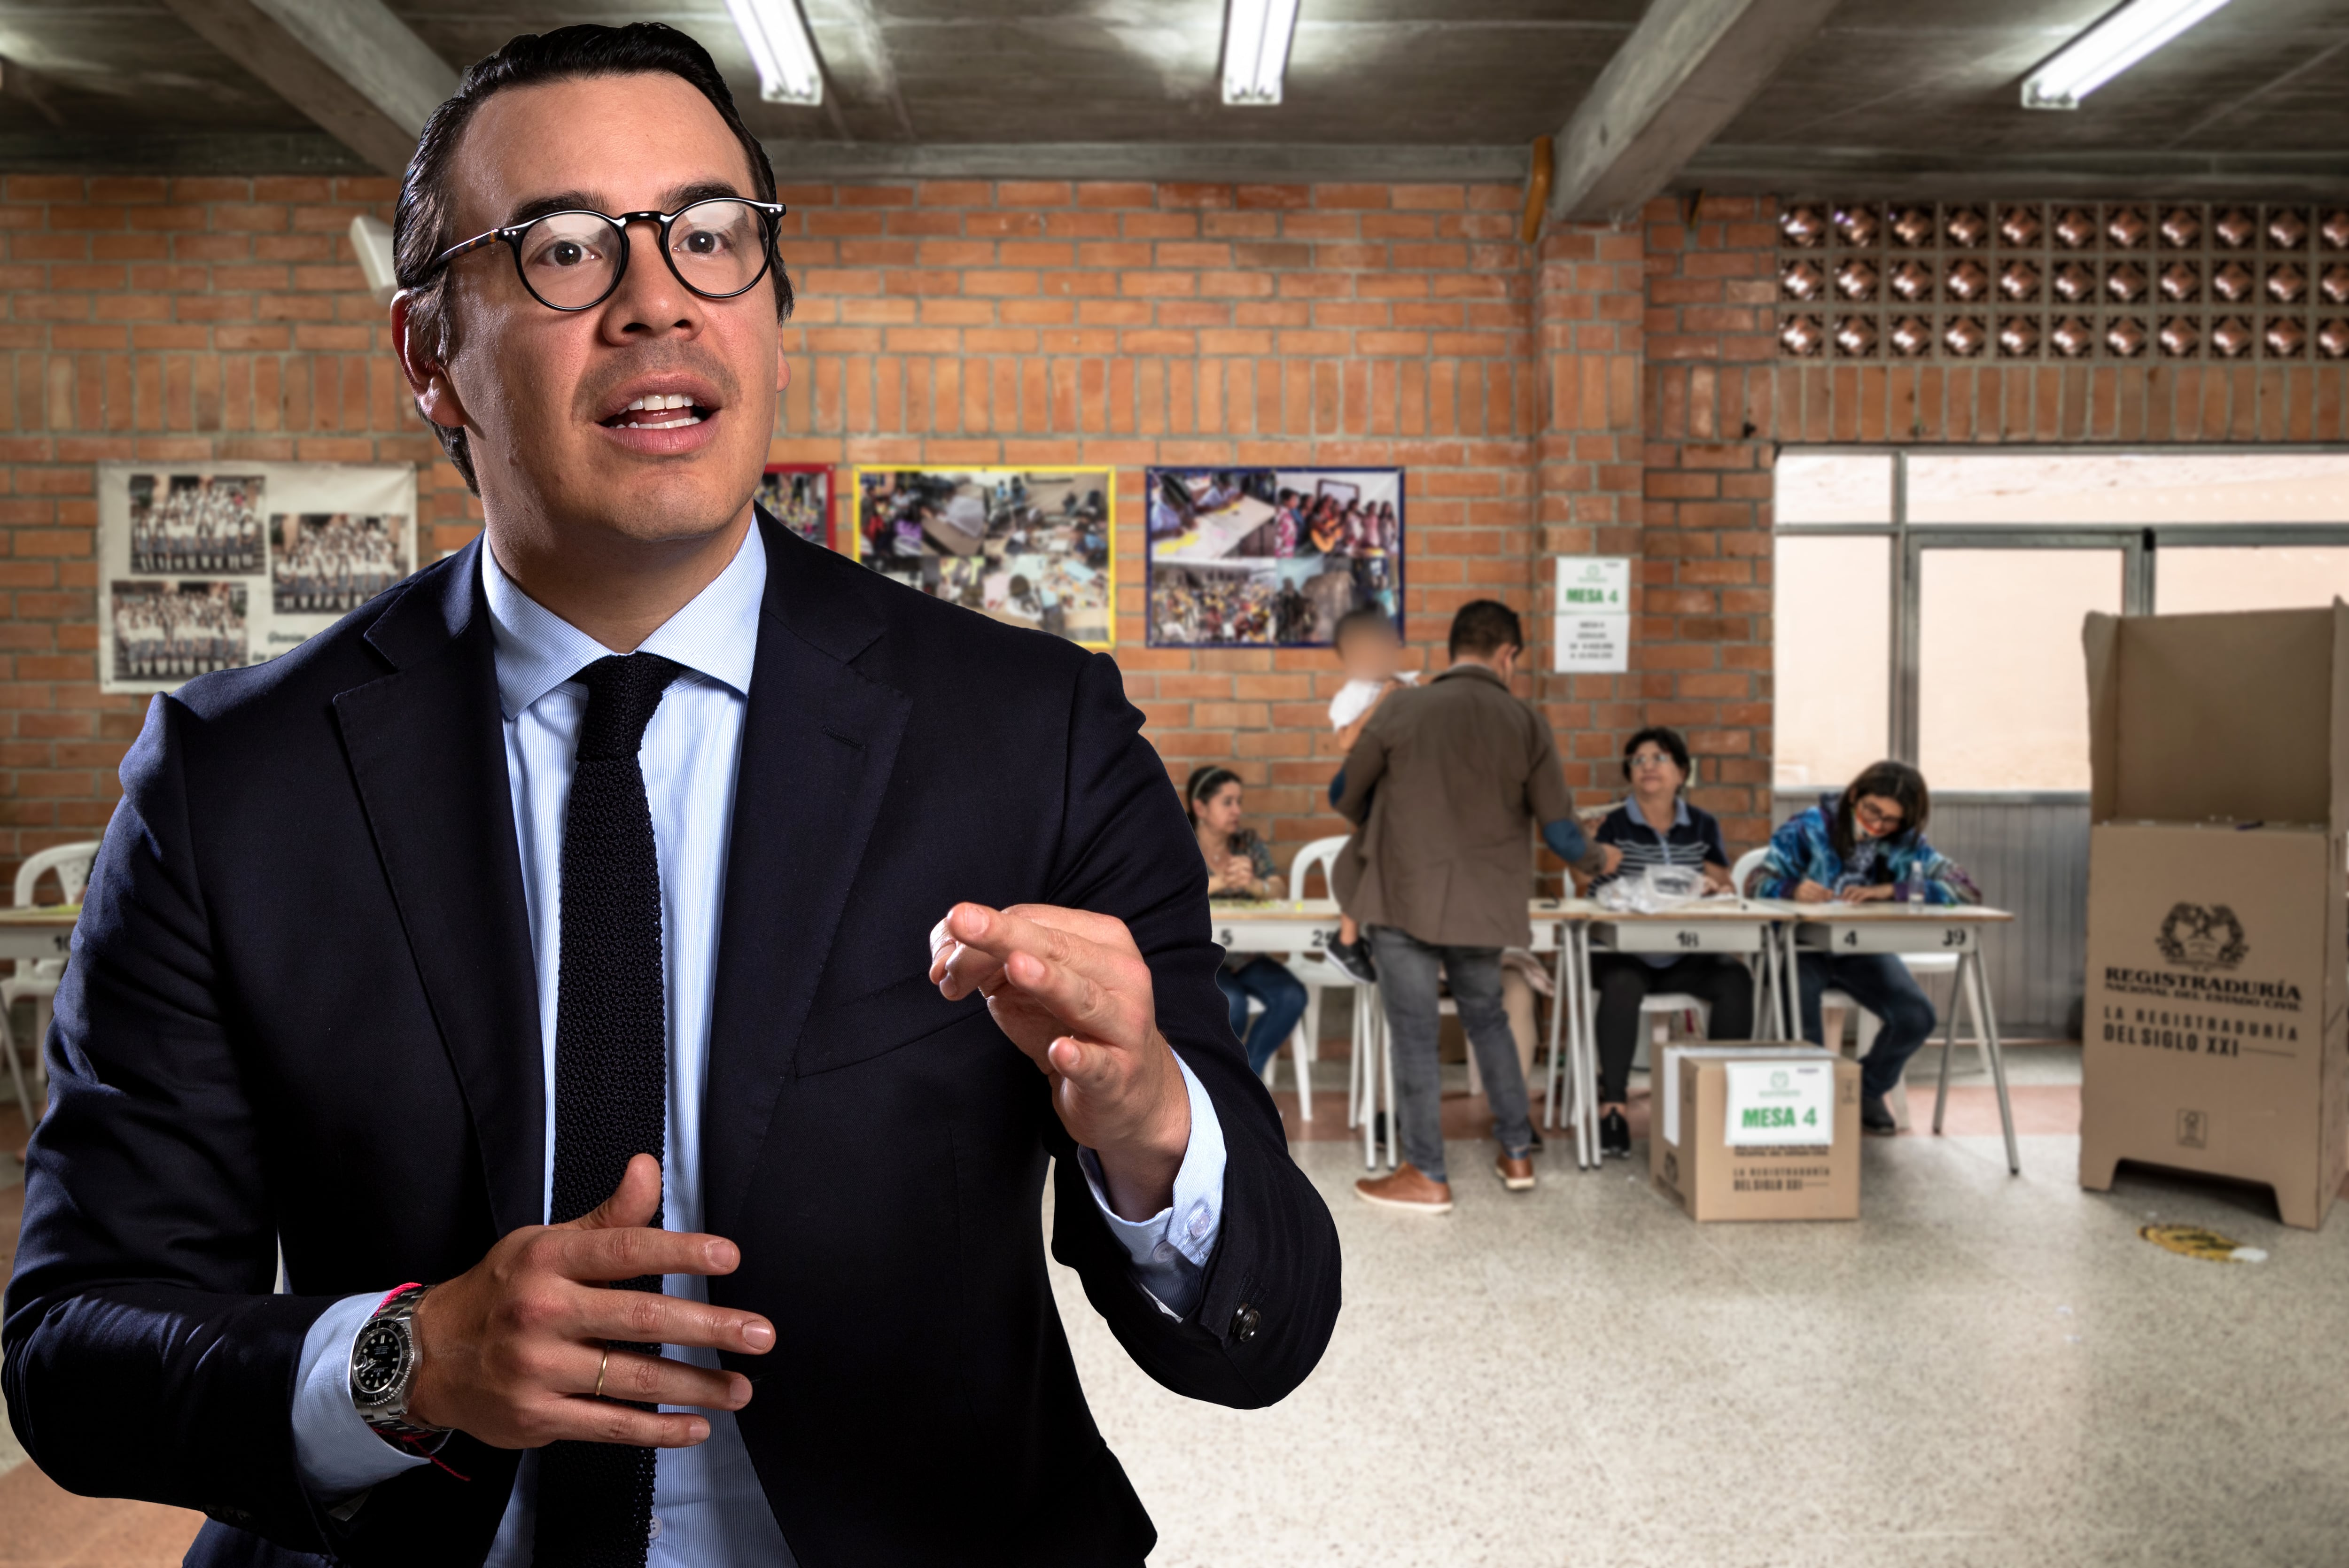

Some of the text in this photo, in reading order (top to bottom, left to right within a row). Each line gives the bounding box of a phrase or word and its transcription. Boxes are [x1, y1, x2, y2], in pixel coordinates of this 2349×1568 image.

[1566, 588, 1618, 604] MESA 4
[1220, 929, 1233, 947] 5
[1843, 930, 1858, 947] 4
[2105, 967, 2302, 1001] REGISTRADURÍA
[2173, 989, 2201, 1001] DEL
[2205, 993, 2260, 1007] ESTADO
[2104, 1005, 2298, 1041] LA REGISTRADURÍA
[2104, 1023, 2238, 1056] DEL SIGLO XXI
[1742, 1106, 1817, 1128] MESA 4
[389, 1321, 397, 1330] 40
[402, 1349, 409, 1359] 50
